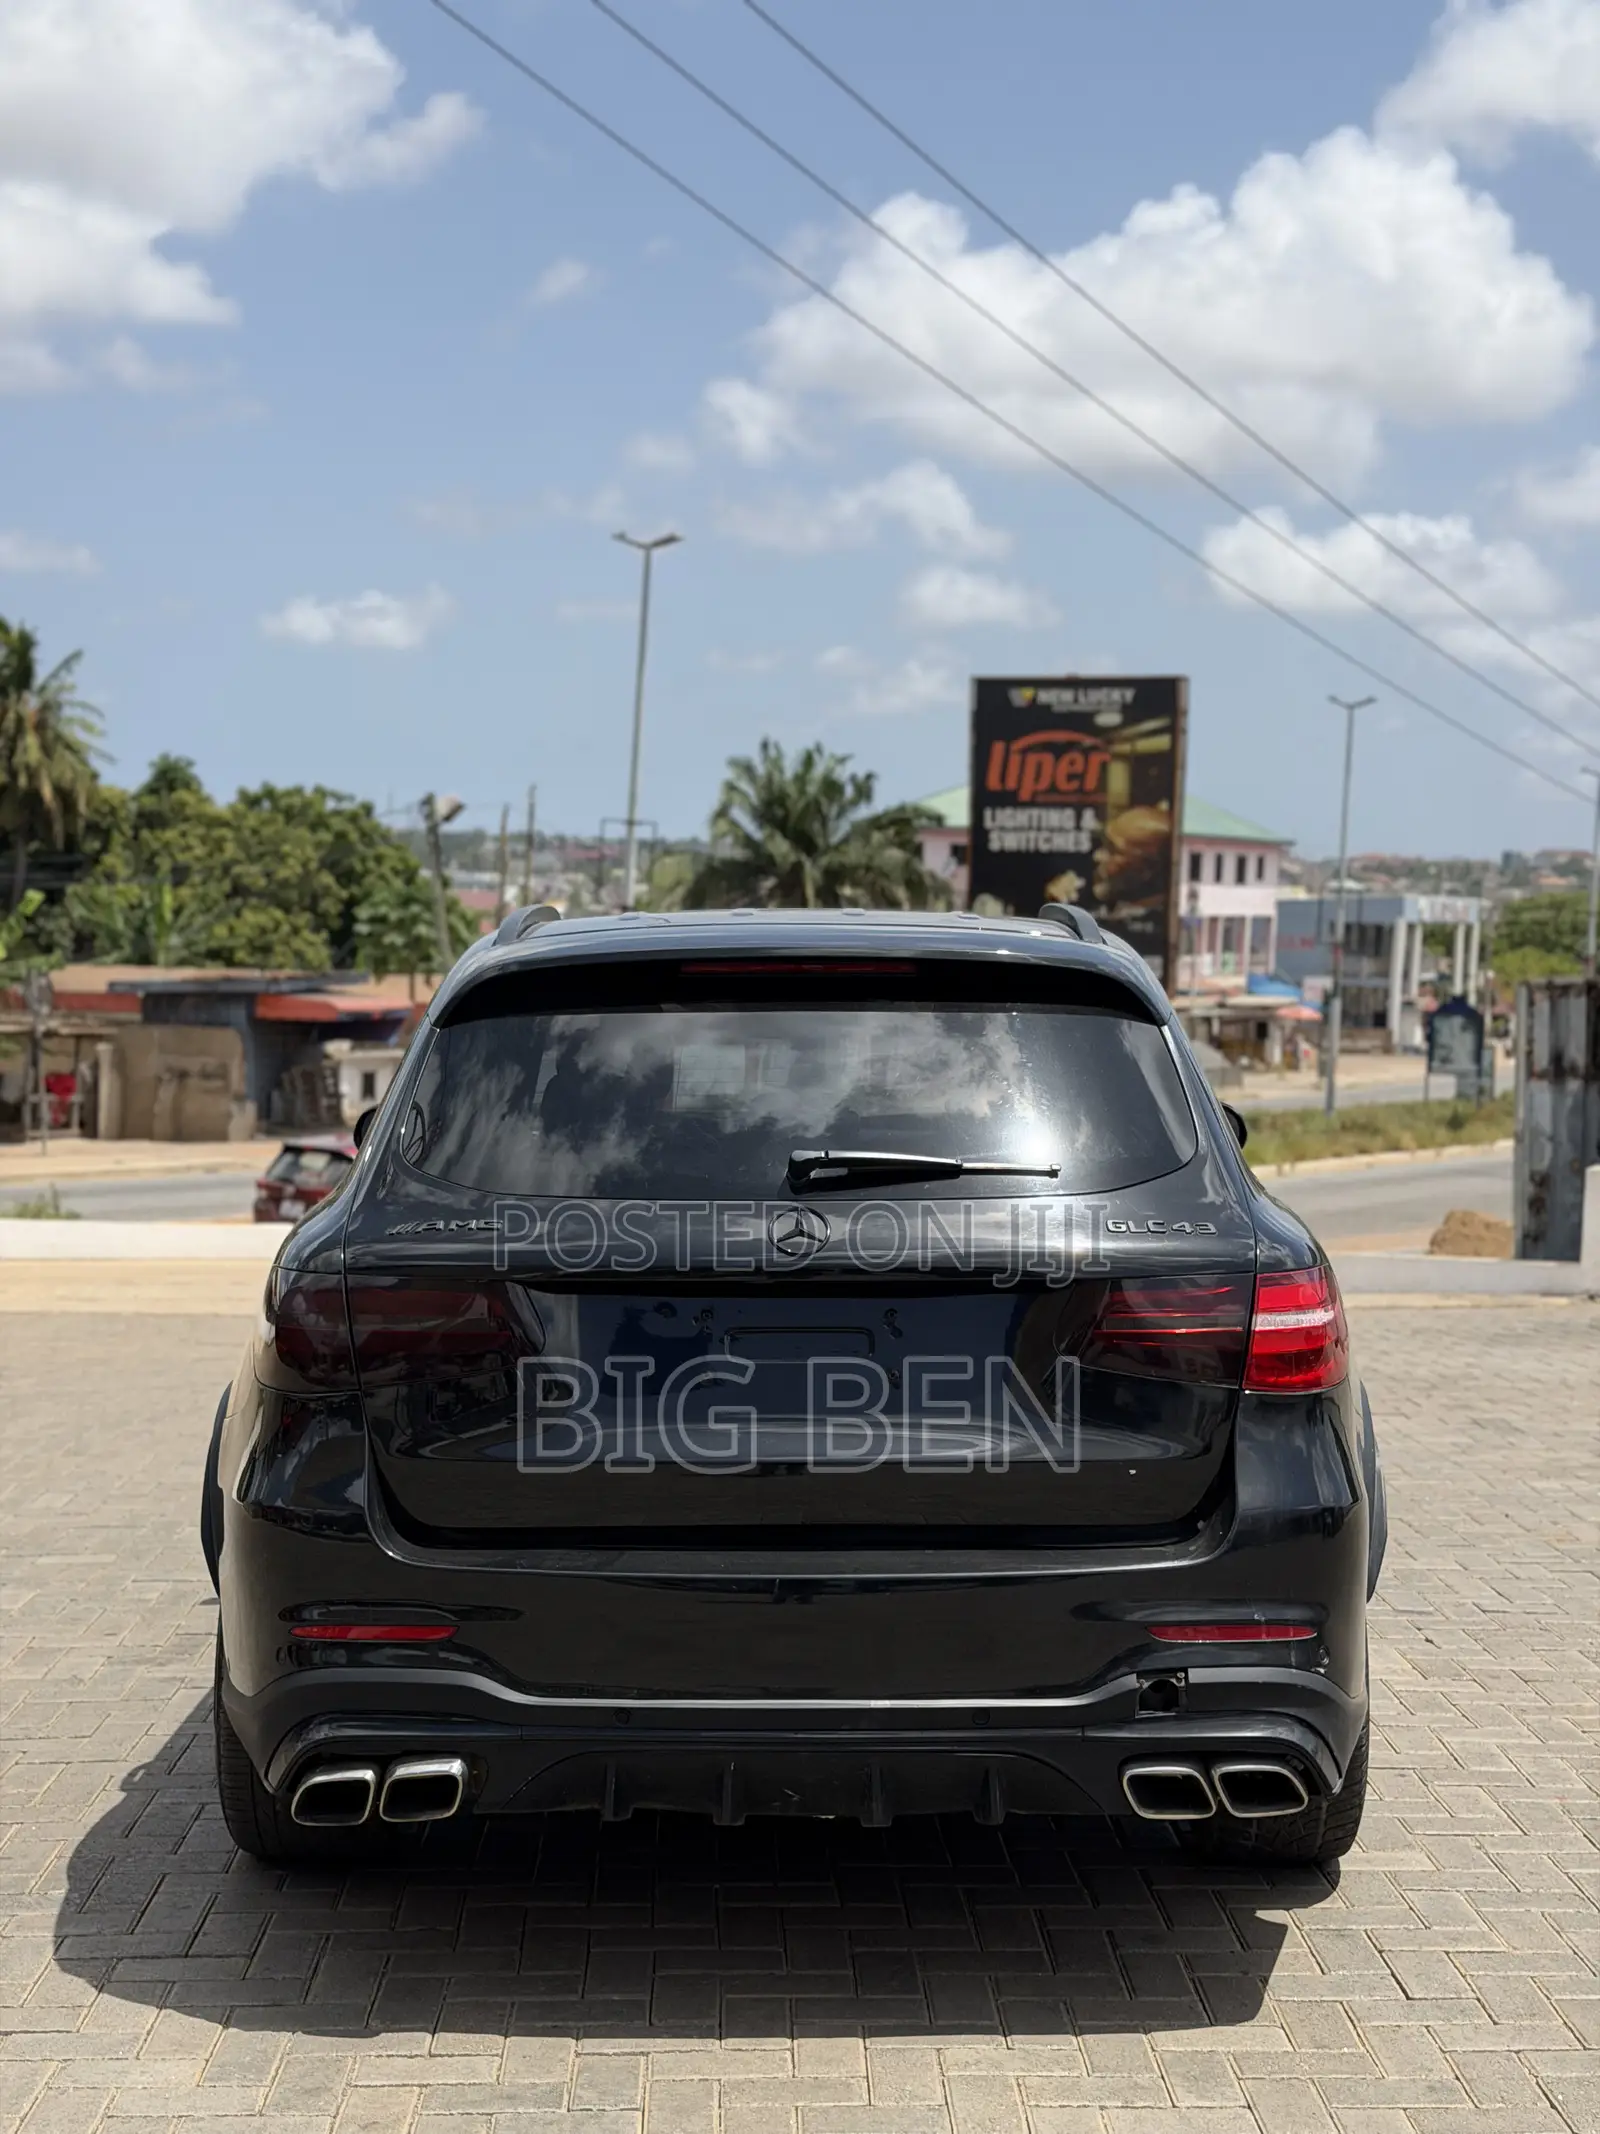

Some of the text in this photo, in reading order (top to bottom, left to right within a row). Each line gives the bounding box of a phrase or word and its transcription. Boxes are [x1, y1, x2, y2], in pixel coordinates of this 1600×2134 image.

[983, 806, 1076, 830] LIGHTING
[988, 830, 1092, 853] SWITCHES
[1106, 1219, 1218, 1236] GLC 43
